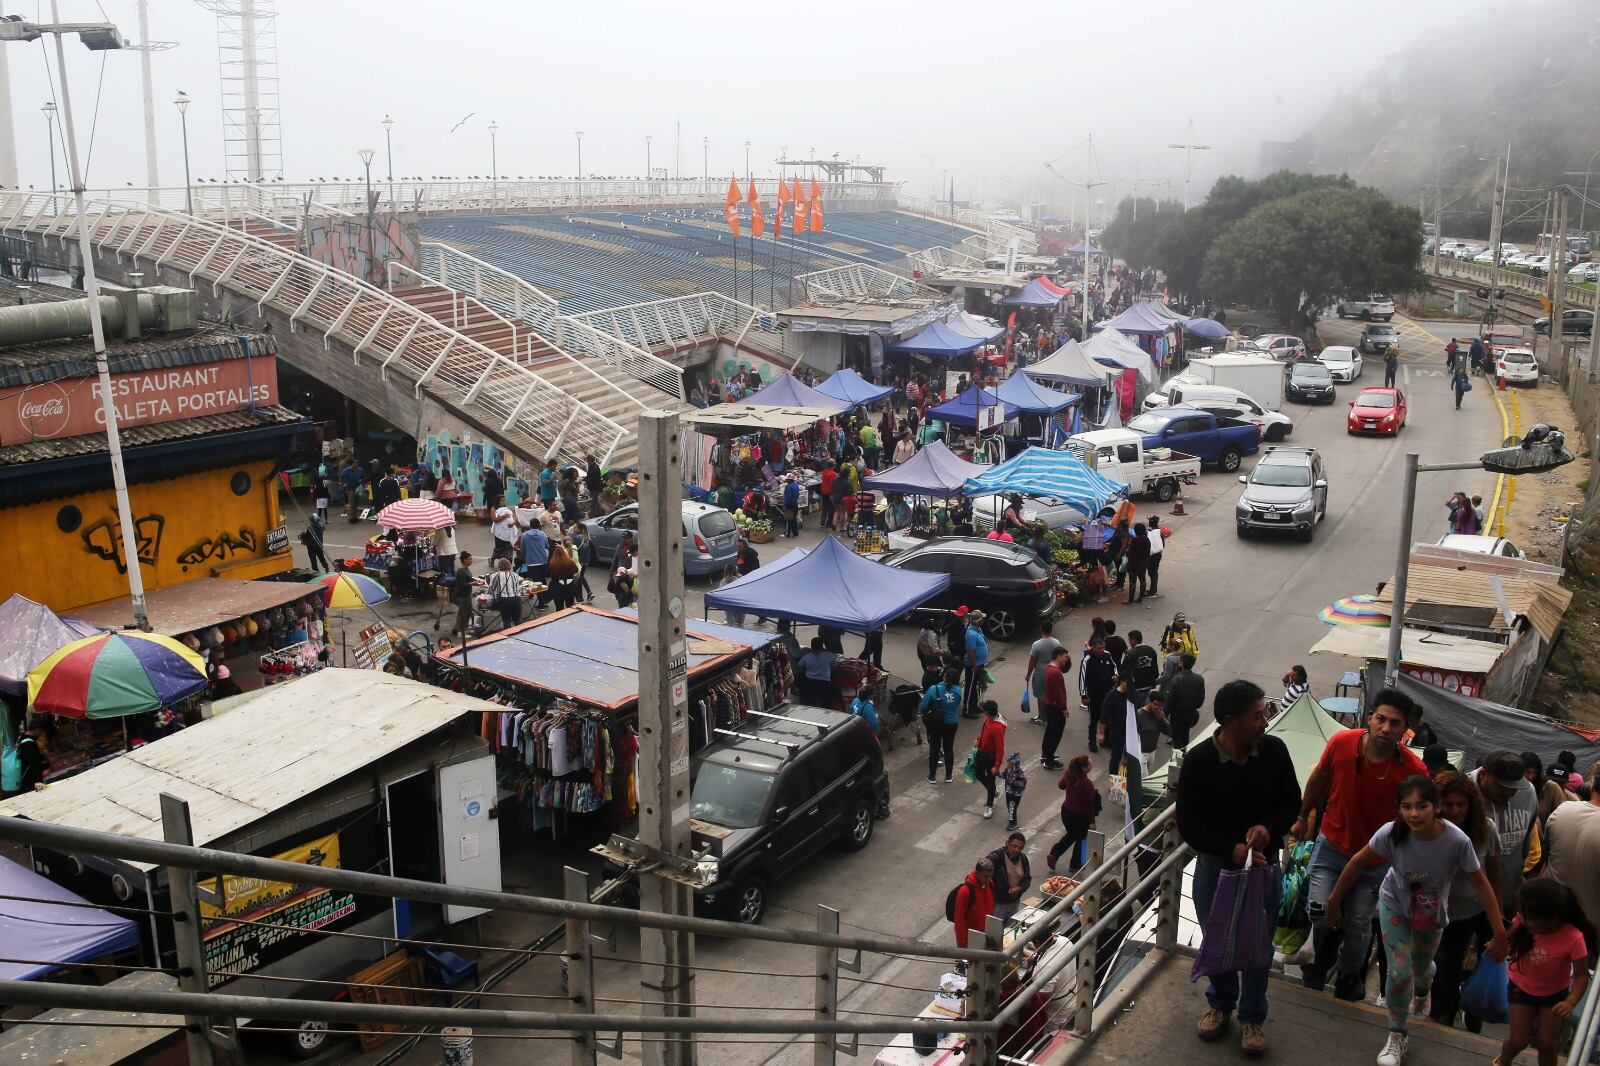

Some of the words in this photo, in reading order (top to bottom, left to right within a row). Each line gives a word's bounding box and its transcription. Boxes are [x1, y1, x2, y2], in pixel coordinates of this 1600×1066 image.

[92, 367, 219, 400] RESTAURANT
[94, 400, 173, 425] CALETA
[178, 384, 270, 414] PORTALES
[299, 893, 354, 926] COMPLETO
[204, 934, 232, 952] RASCO
